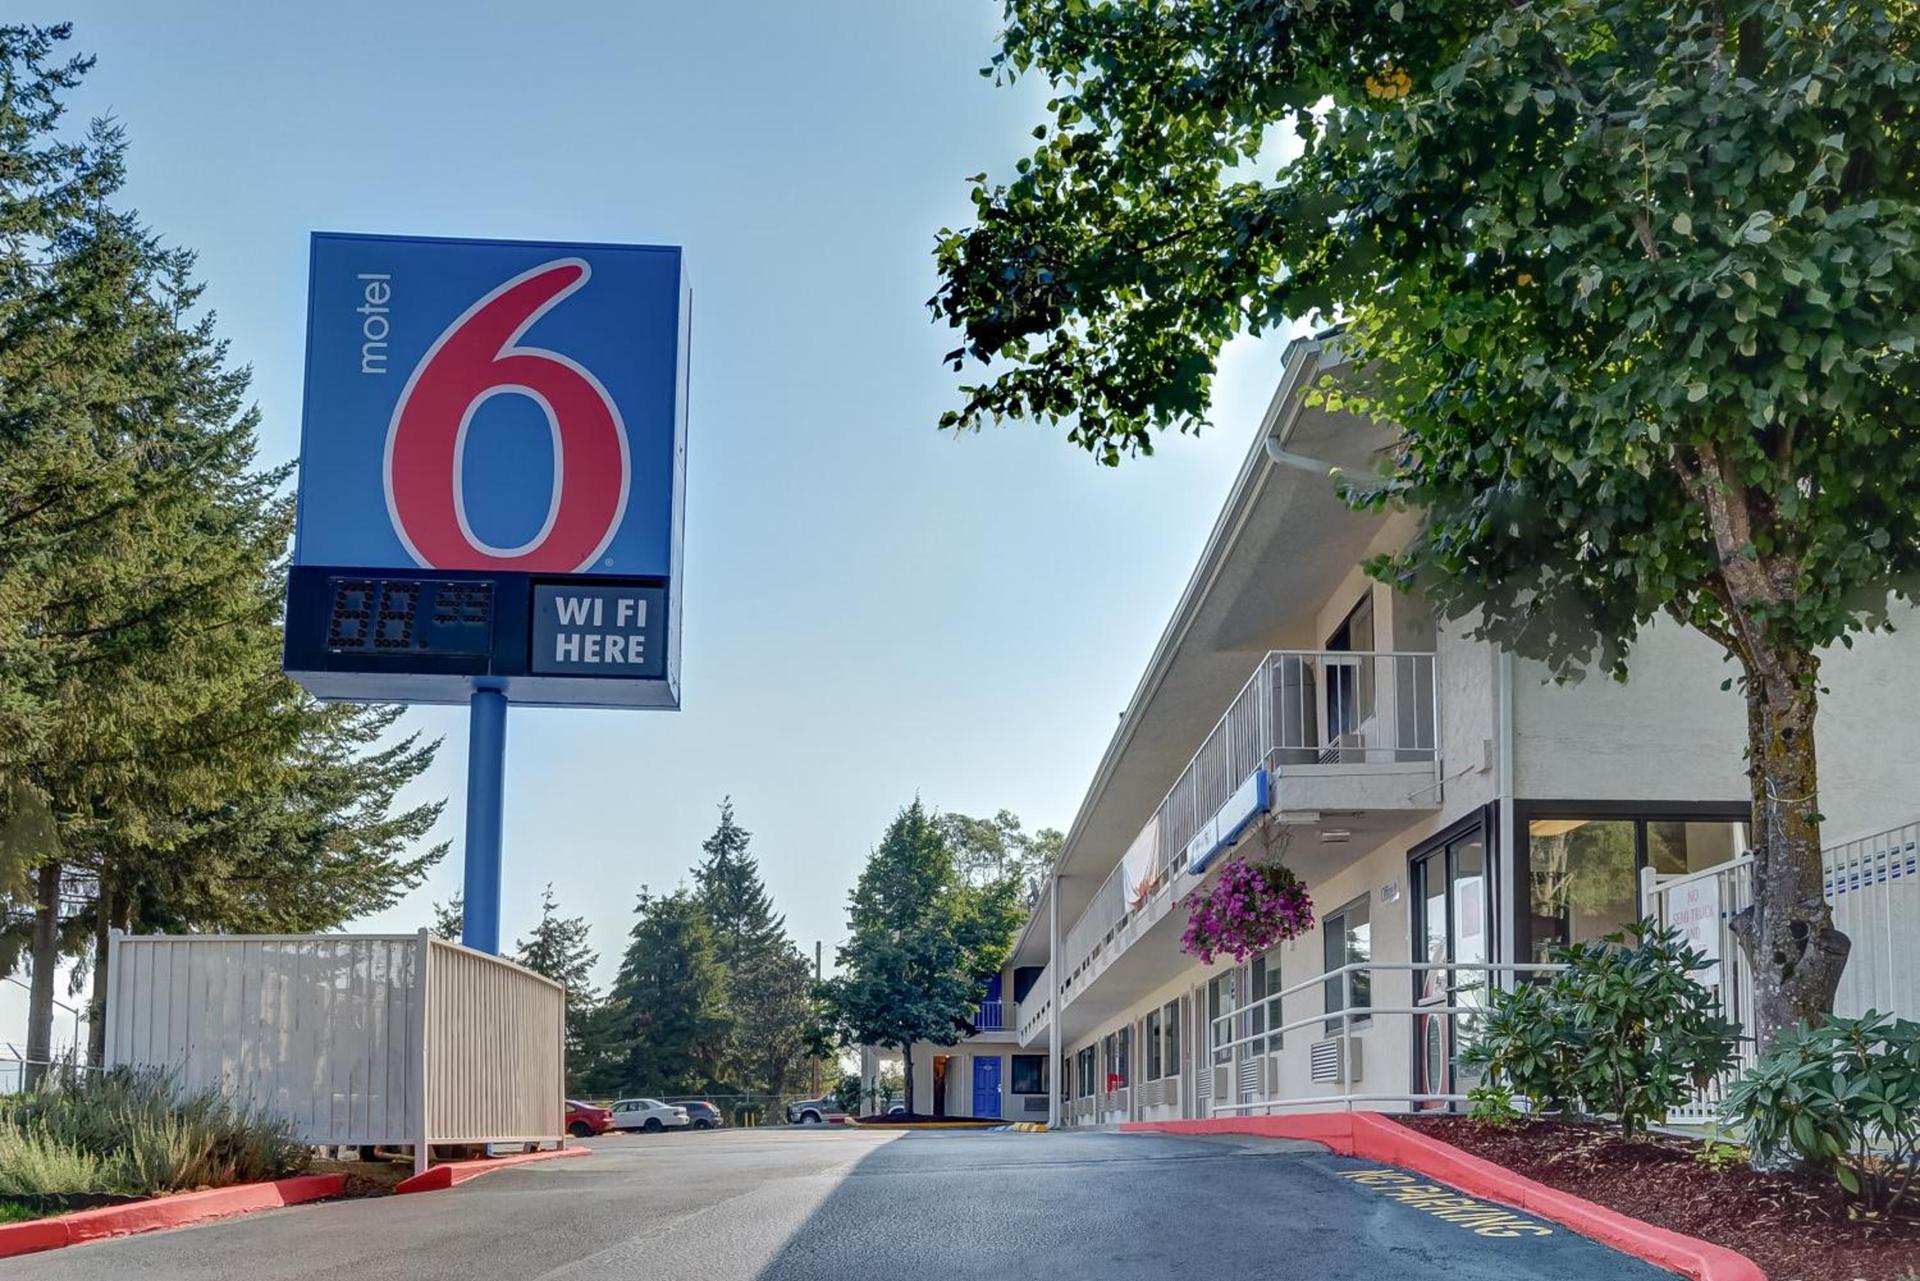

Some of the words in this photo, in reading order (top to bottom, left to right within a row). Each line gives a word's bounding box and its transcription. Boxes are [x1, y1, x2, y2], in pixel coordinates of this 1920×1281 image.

[356, 273, 392, 374] motel
[382, 256, 632, 573] 6
[555, 596, 604, 627] WI
[616, 598, 648, 628] FI
[555, 632, 646, 664] HERE
[1687, 888, 1699, 903] NO
[1335, 1169, 1416, 1184] NO
[1371, 1184, 1553, 1238] PARKING
